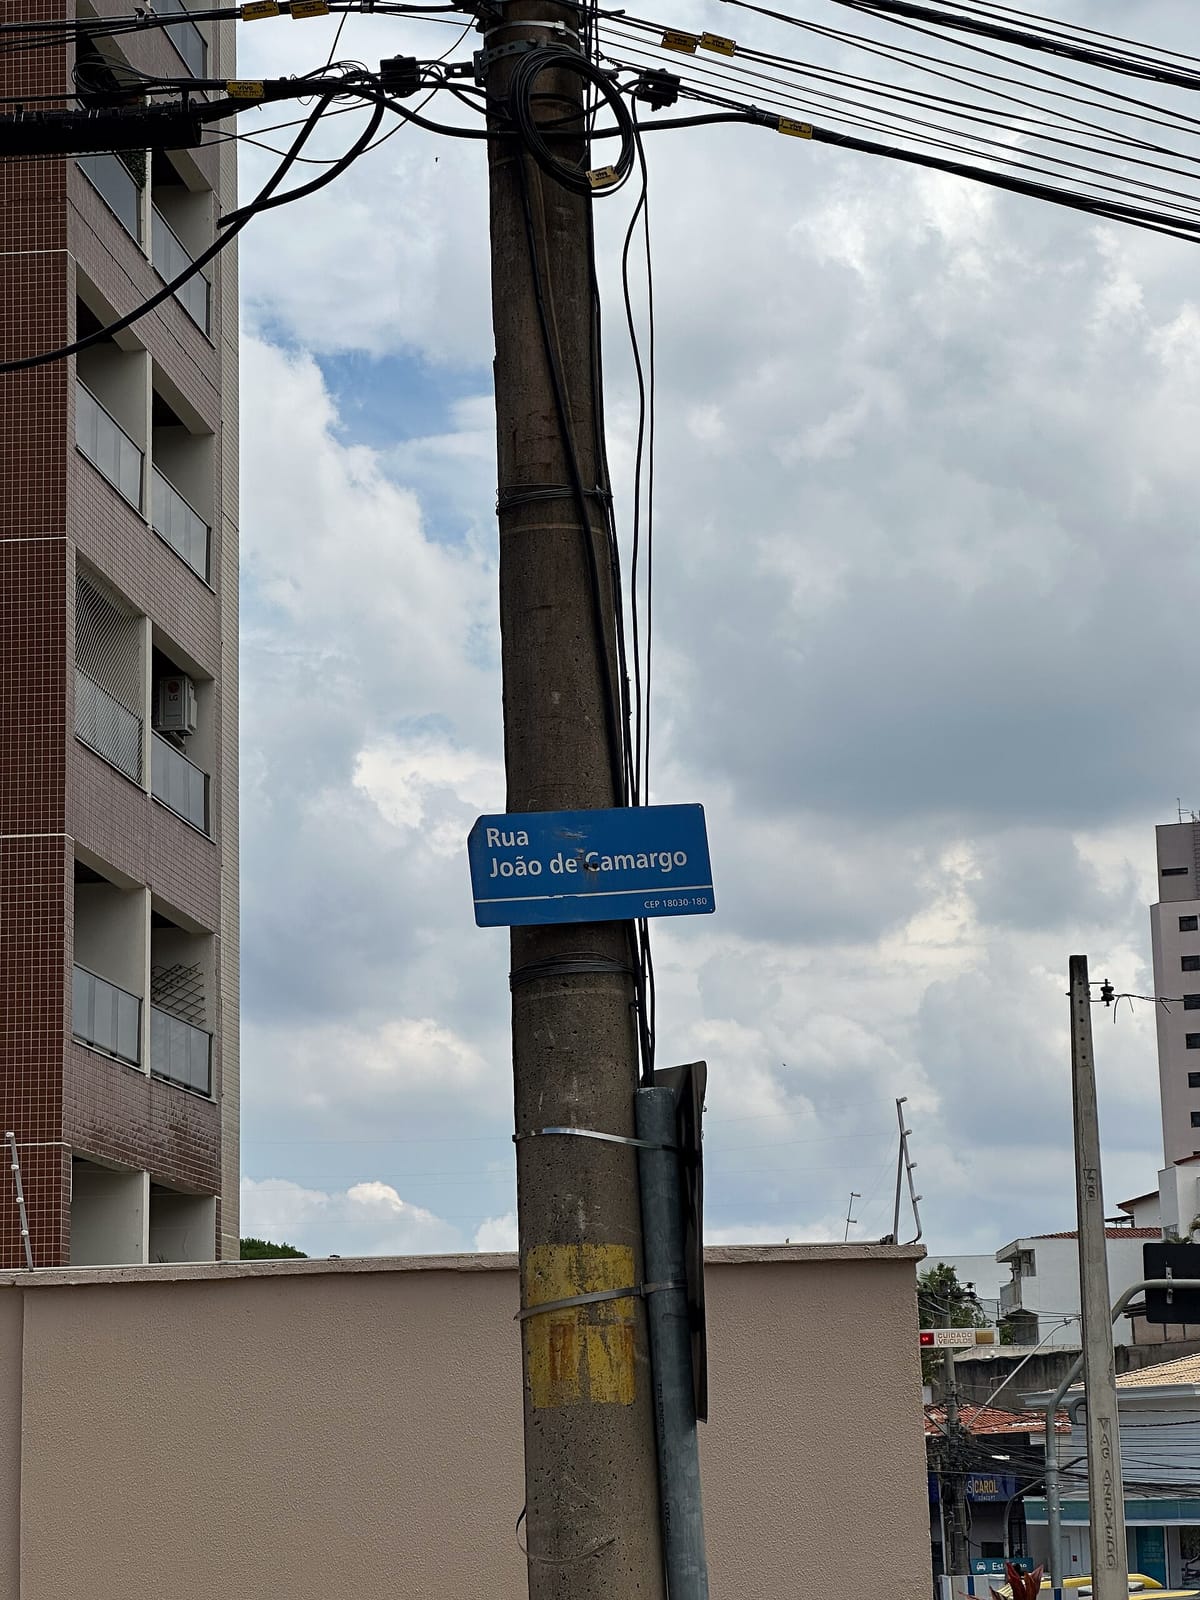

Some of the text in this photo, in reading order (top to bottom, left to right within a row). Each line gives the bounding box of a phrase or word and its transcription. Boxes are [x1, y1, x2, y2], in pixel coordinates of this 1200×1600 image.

[486, 827, 529, 848] Rua
[489, 850, 688, 878] João de Camargo
[644, 897, 708, 909] CEP 18030-180
[974, 1479, 999, 1494] CAROL
